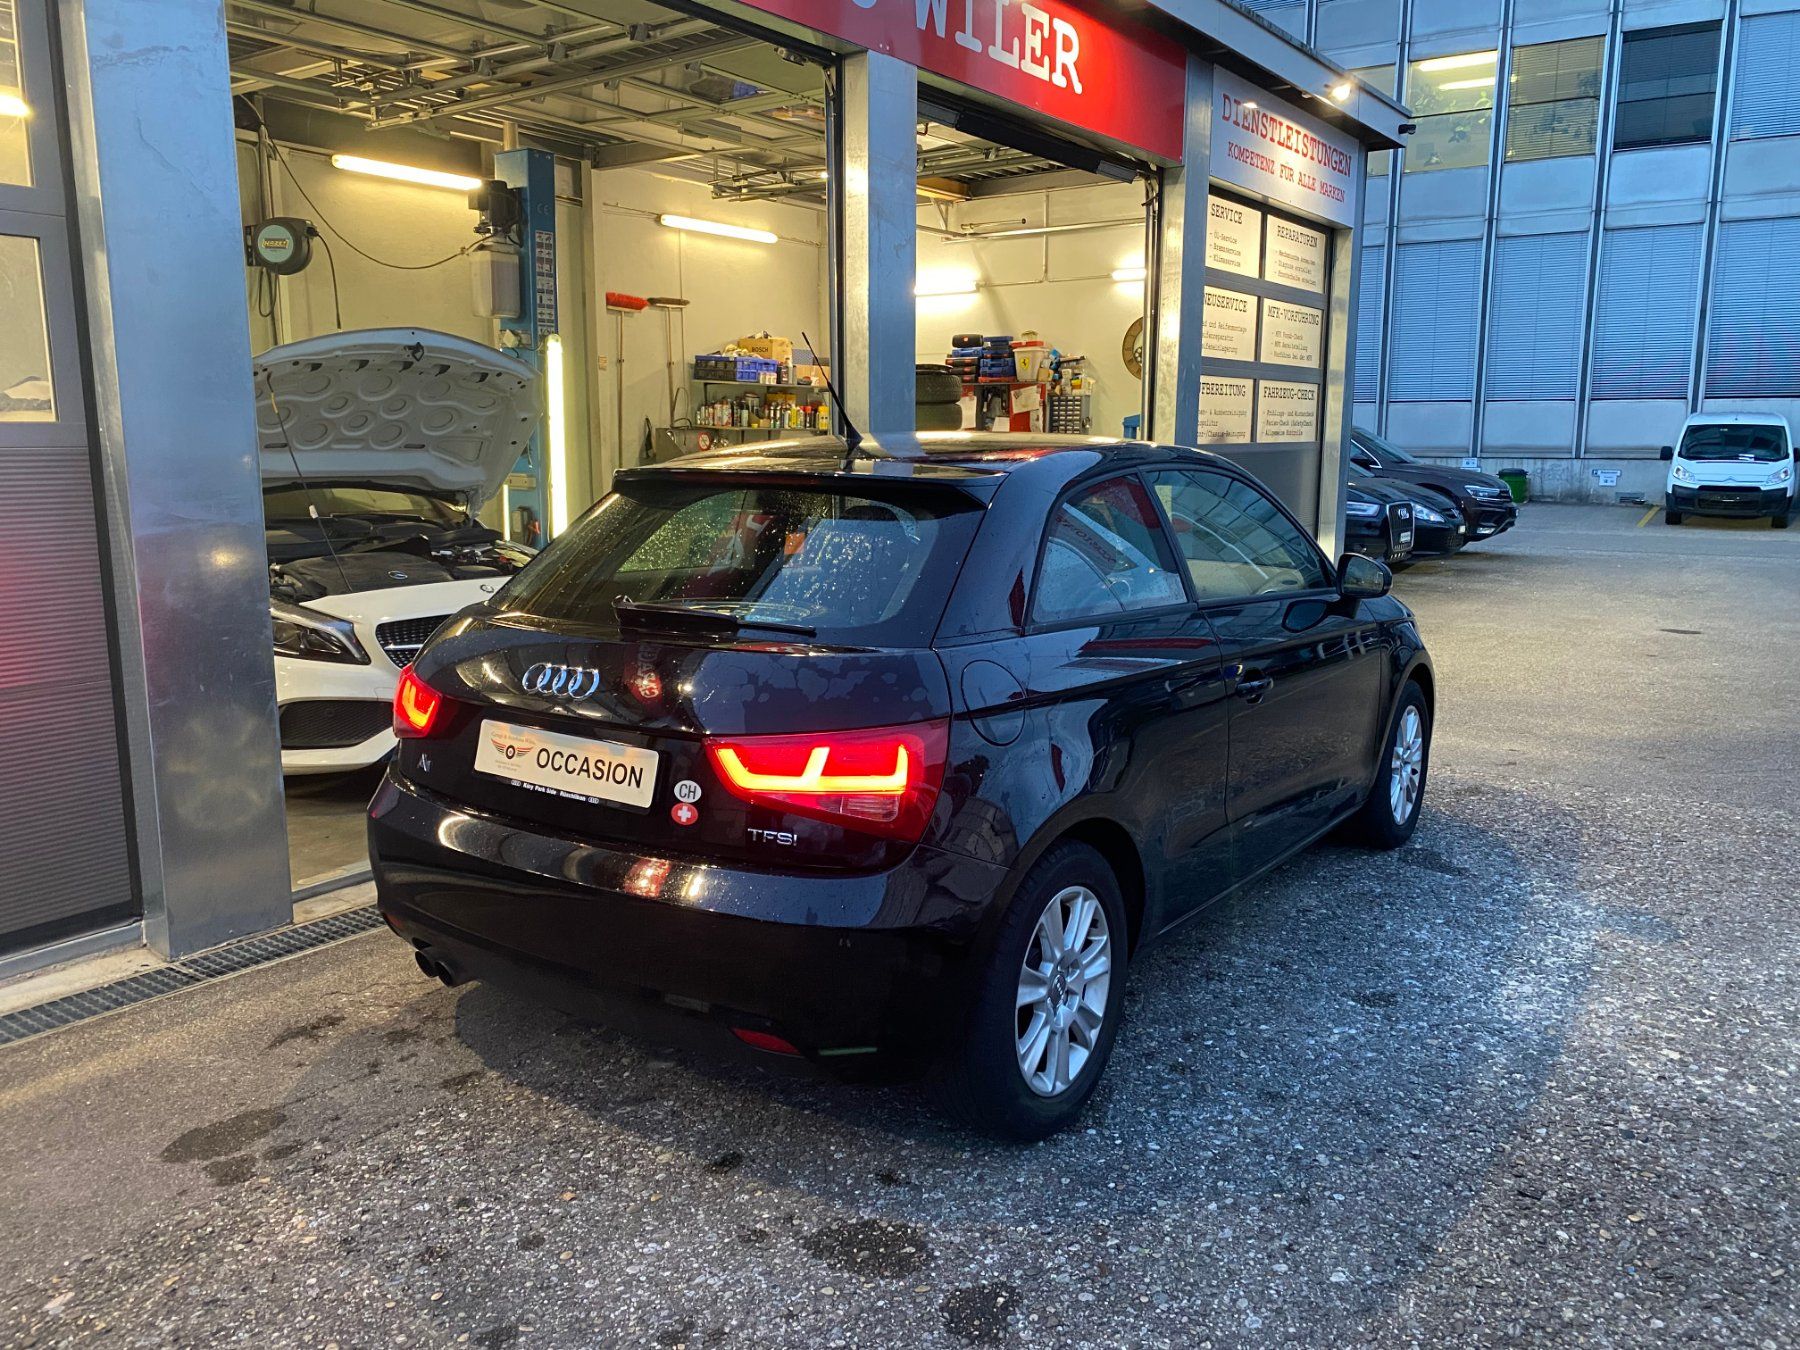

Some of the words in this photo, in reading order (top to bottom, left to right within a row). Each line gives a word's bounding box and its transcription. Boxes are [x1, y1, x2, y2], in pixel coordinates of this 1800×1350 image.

[1222, 92, 1352, 178] DIENSTLEISTUNGEN
[1228, 141, 1275, 175] KOMPETENZ
[1298, 172, 1317, 192] ALLE
[1320, 180, 1346, 203] MARKEN
[1211, 203, 1243, 225] SERVICE
[1277, 225, 1318, 248] REPARATUREN
[1199, 382, 1246, 397] FBEREITUNG
[1263, 386, 1316, 401] FAHRZEUG-CHECK
[536, 747, 644, 789] OCCASION
[534, 785, 546, 793] Park
[678, 783, 697, 800] CH
[747, 828, 798, 847] TFSI
